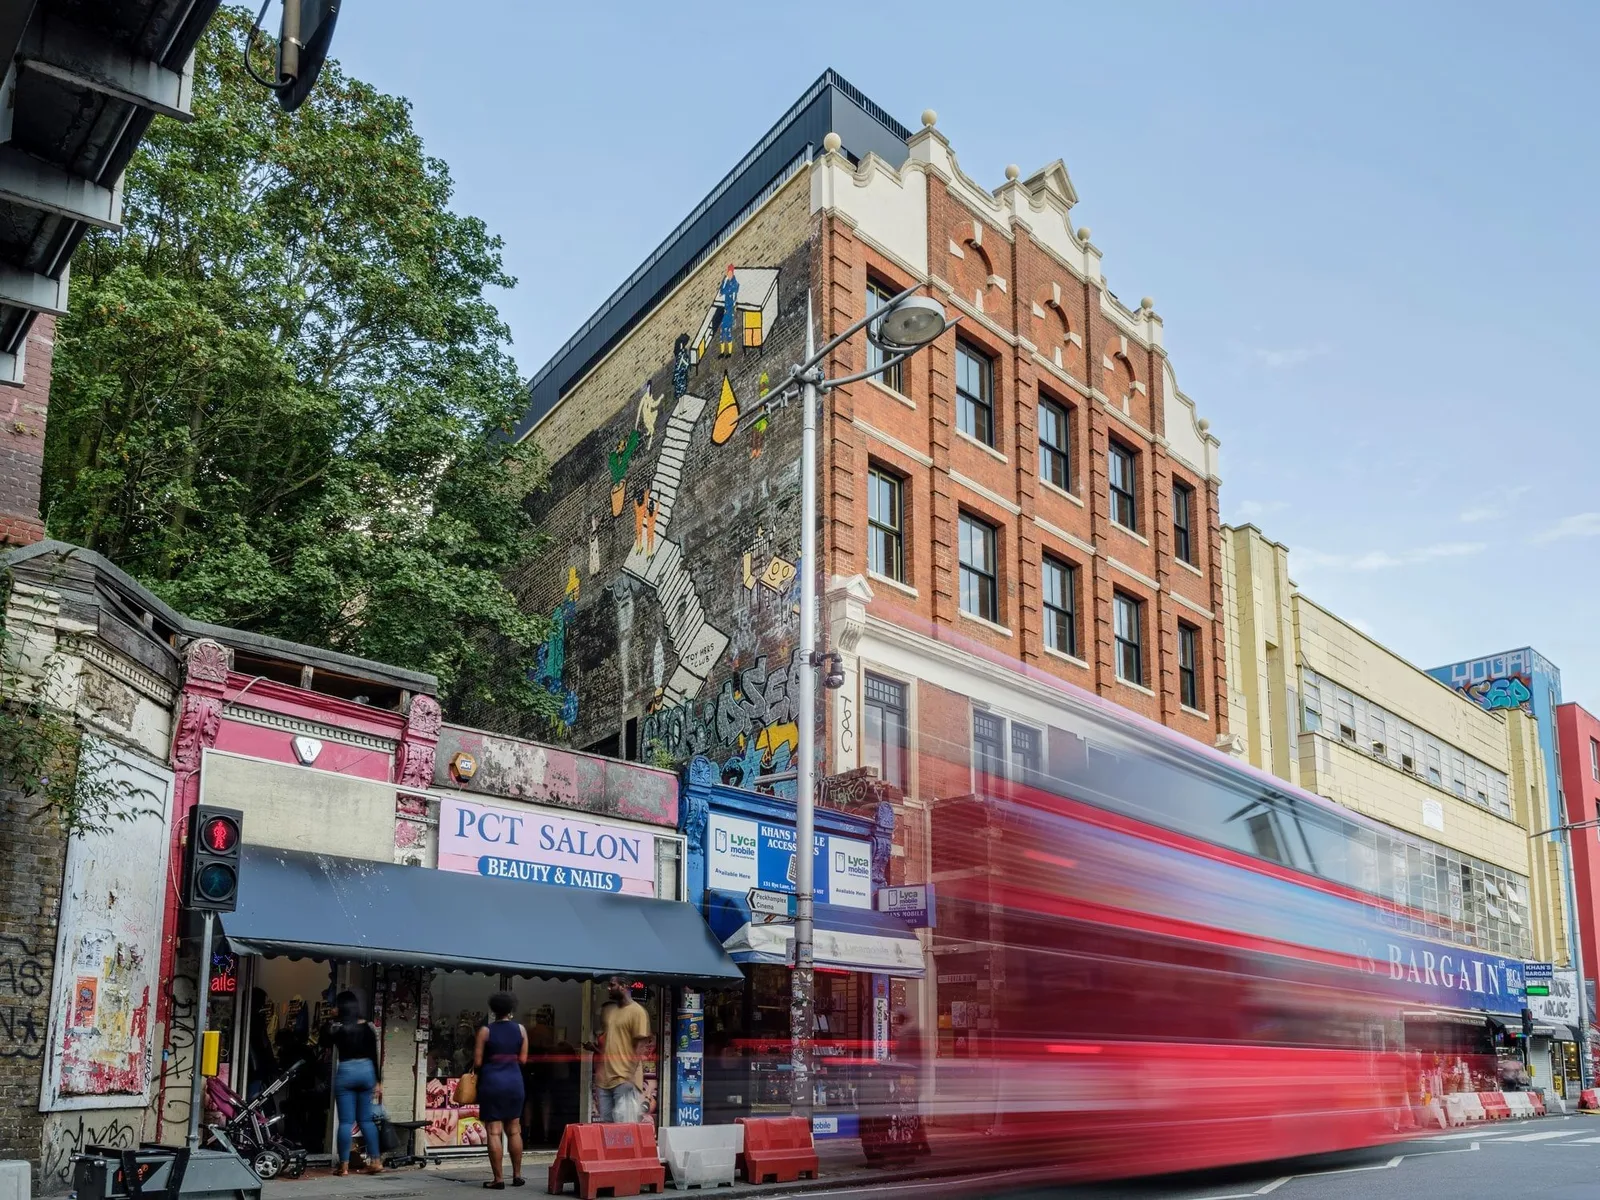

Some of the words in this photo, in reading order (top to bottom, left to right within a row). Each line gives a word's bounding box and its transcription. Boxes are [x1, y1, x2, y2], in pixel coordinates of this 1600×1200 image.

[454, 808, 524, 845] PCT
[539, 824, 641, 864] SALON
[761, 825, 791, 840] KHANS
[730, 834, 756, 847] Lyca
[730, 846, 755, 856] mobile
[848, 855, 869, 867] Lyca
[487, 857, 551, 882] BEAUTY
[554, 869, 566, 884] &
[570, 872, 613, 890] NAILS
[714, 867, 738, 878] Available
[739, 872, 751, 880] Here
[848, 866, 869, 875] mobile
[756, 893, 787, 904] Peckhamplex
[899, 890, 918, 899] Lyca
[756, 902, 774, 910] Cinema
[1387, 943, 1500, 995] BARGAIN
[211, 972, 236, 992] ails
[1544, 1000, 1568, 1018] ARCADE
